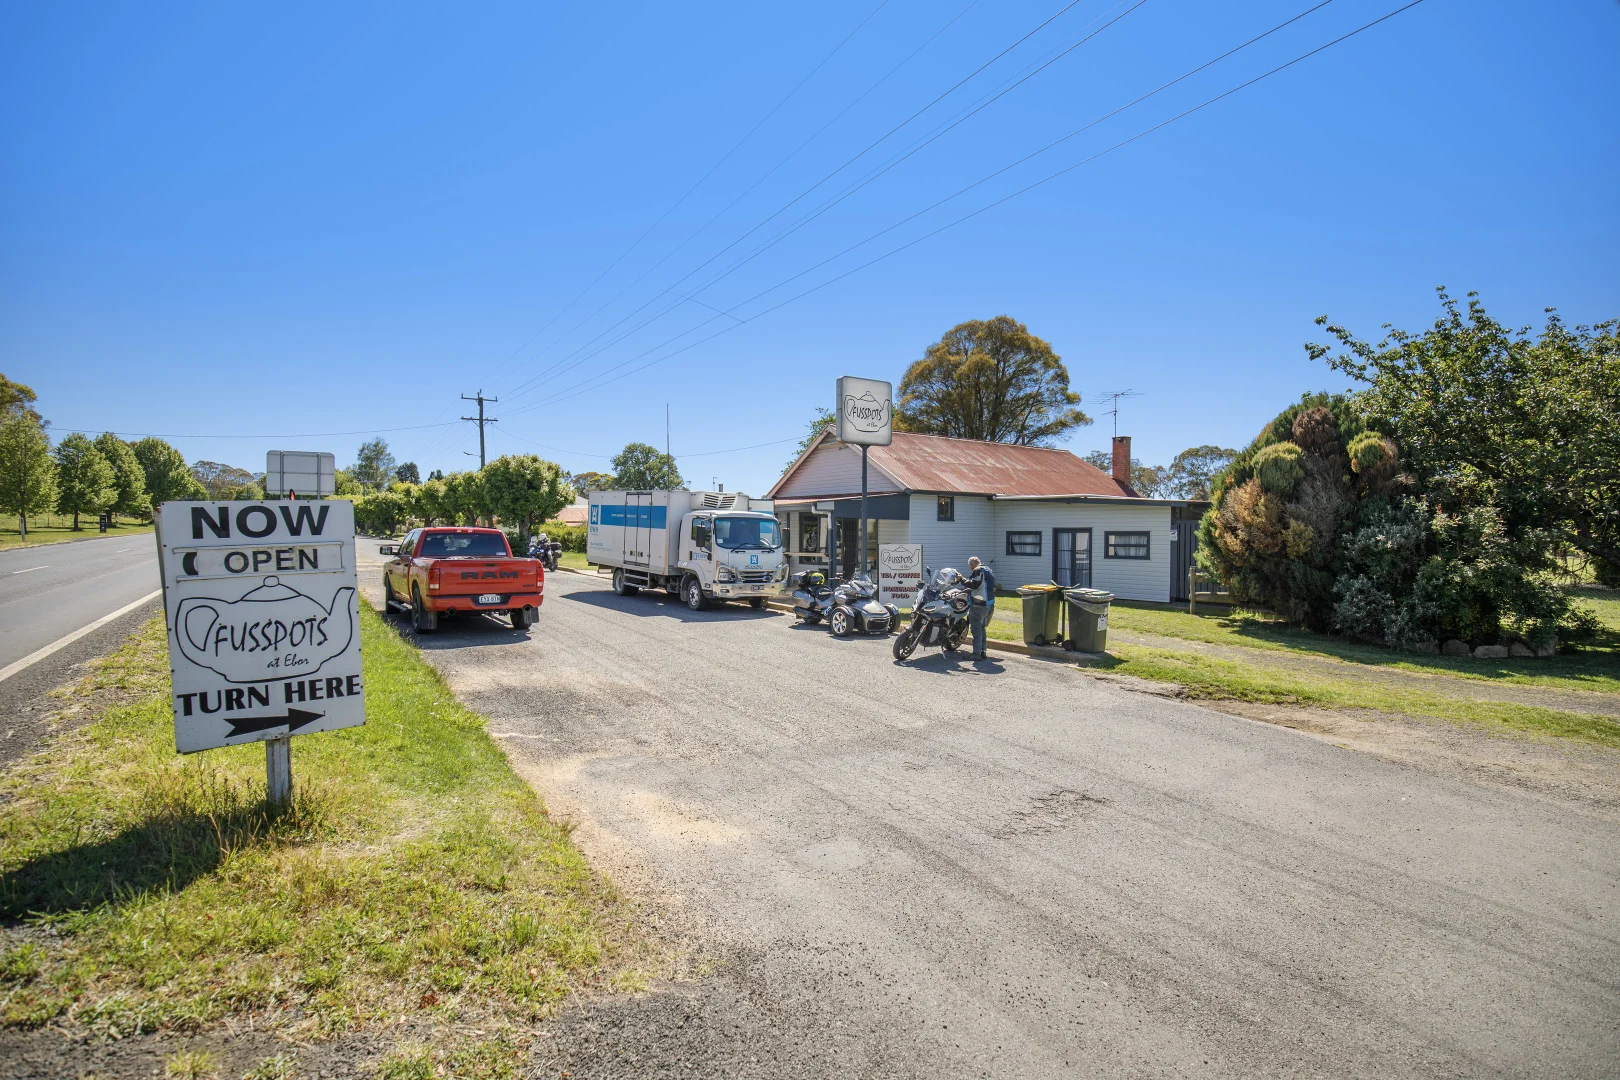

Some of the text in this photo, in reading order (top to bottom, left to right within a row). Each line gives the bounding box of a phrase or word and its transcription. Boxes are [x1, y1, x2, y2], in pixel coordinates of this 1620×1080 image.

[852, 406, 882, 421] FUSSPOTS
[191, 505, 330, 539] NOW
[224, 548, 319, 573] OPEN
[888, 556, 913, 564] FUSSPOTS
[462, 571, 518, 580] RAM
[213, 615, 329, 657] FUSSPOTS
[267, 653, 310, 669] at Ebor
[176, 674, 361, 717] TURN HERE
